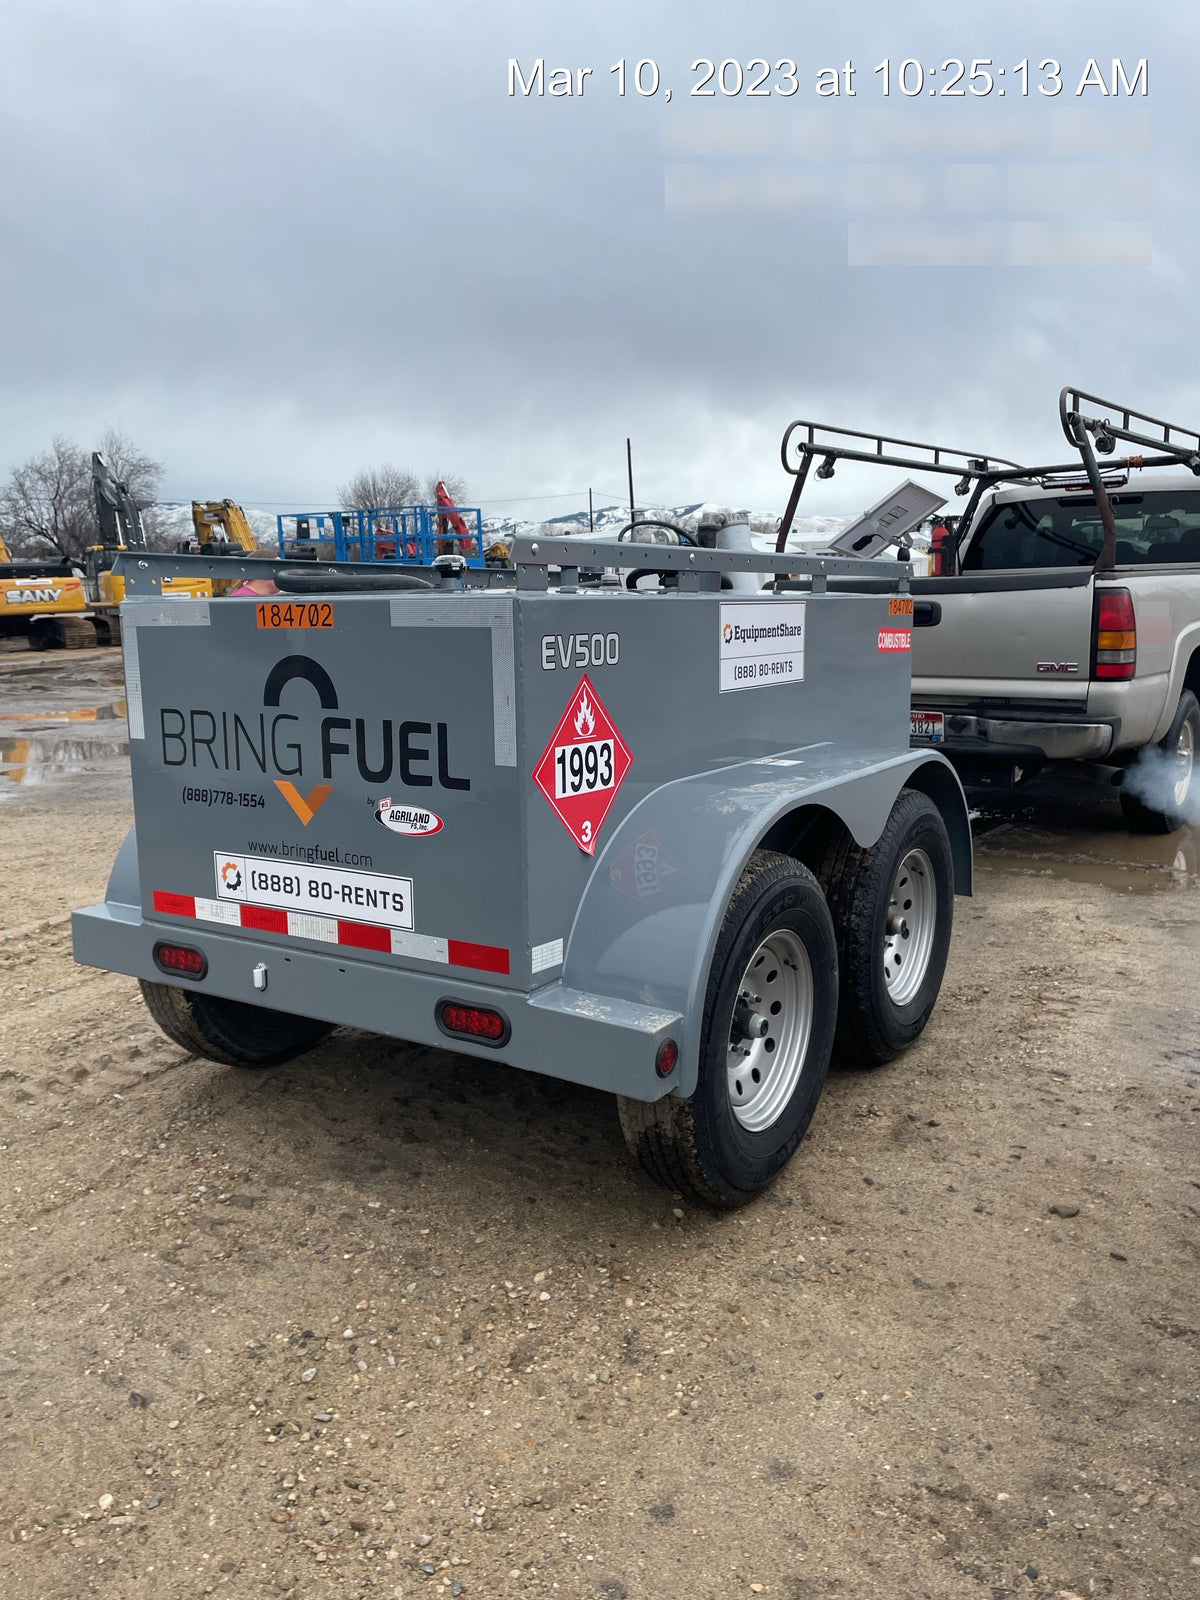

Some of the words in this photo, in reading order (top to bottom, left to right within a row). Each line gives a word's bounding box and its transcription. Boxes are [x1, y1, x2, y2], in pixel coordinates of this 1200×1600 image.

[6, 588, 62, 604] SANY
[258, 603, 333, 628] 184702
[734, 623, 802, 643] EquipmentShare
[878, 632, 911, 649] COMBUSTIBLE
[540, 632, 619, 671] EV500
[734, 664, 757, 681] (888)
[758, 661, 793, 677] 80-RENTS
[1037, 662, 1079, 672] GMC
[160, 708, 303, 777] BRING
[321, 717, 471, 791] FUEL
[556, 743, 613, 795] 1993
[182, 786, 266, 809] (888)778-1554
[367, 797, 375, 807] by
[389, 810, 430, 824] AGRILAND
[581, 820, 592, 843] 3
[248, 840, 373, 867] www.bringfuel.com
[251, 870, 301, 897] (888)
[308, 880, 404, 912] 80-RENTS
